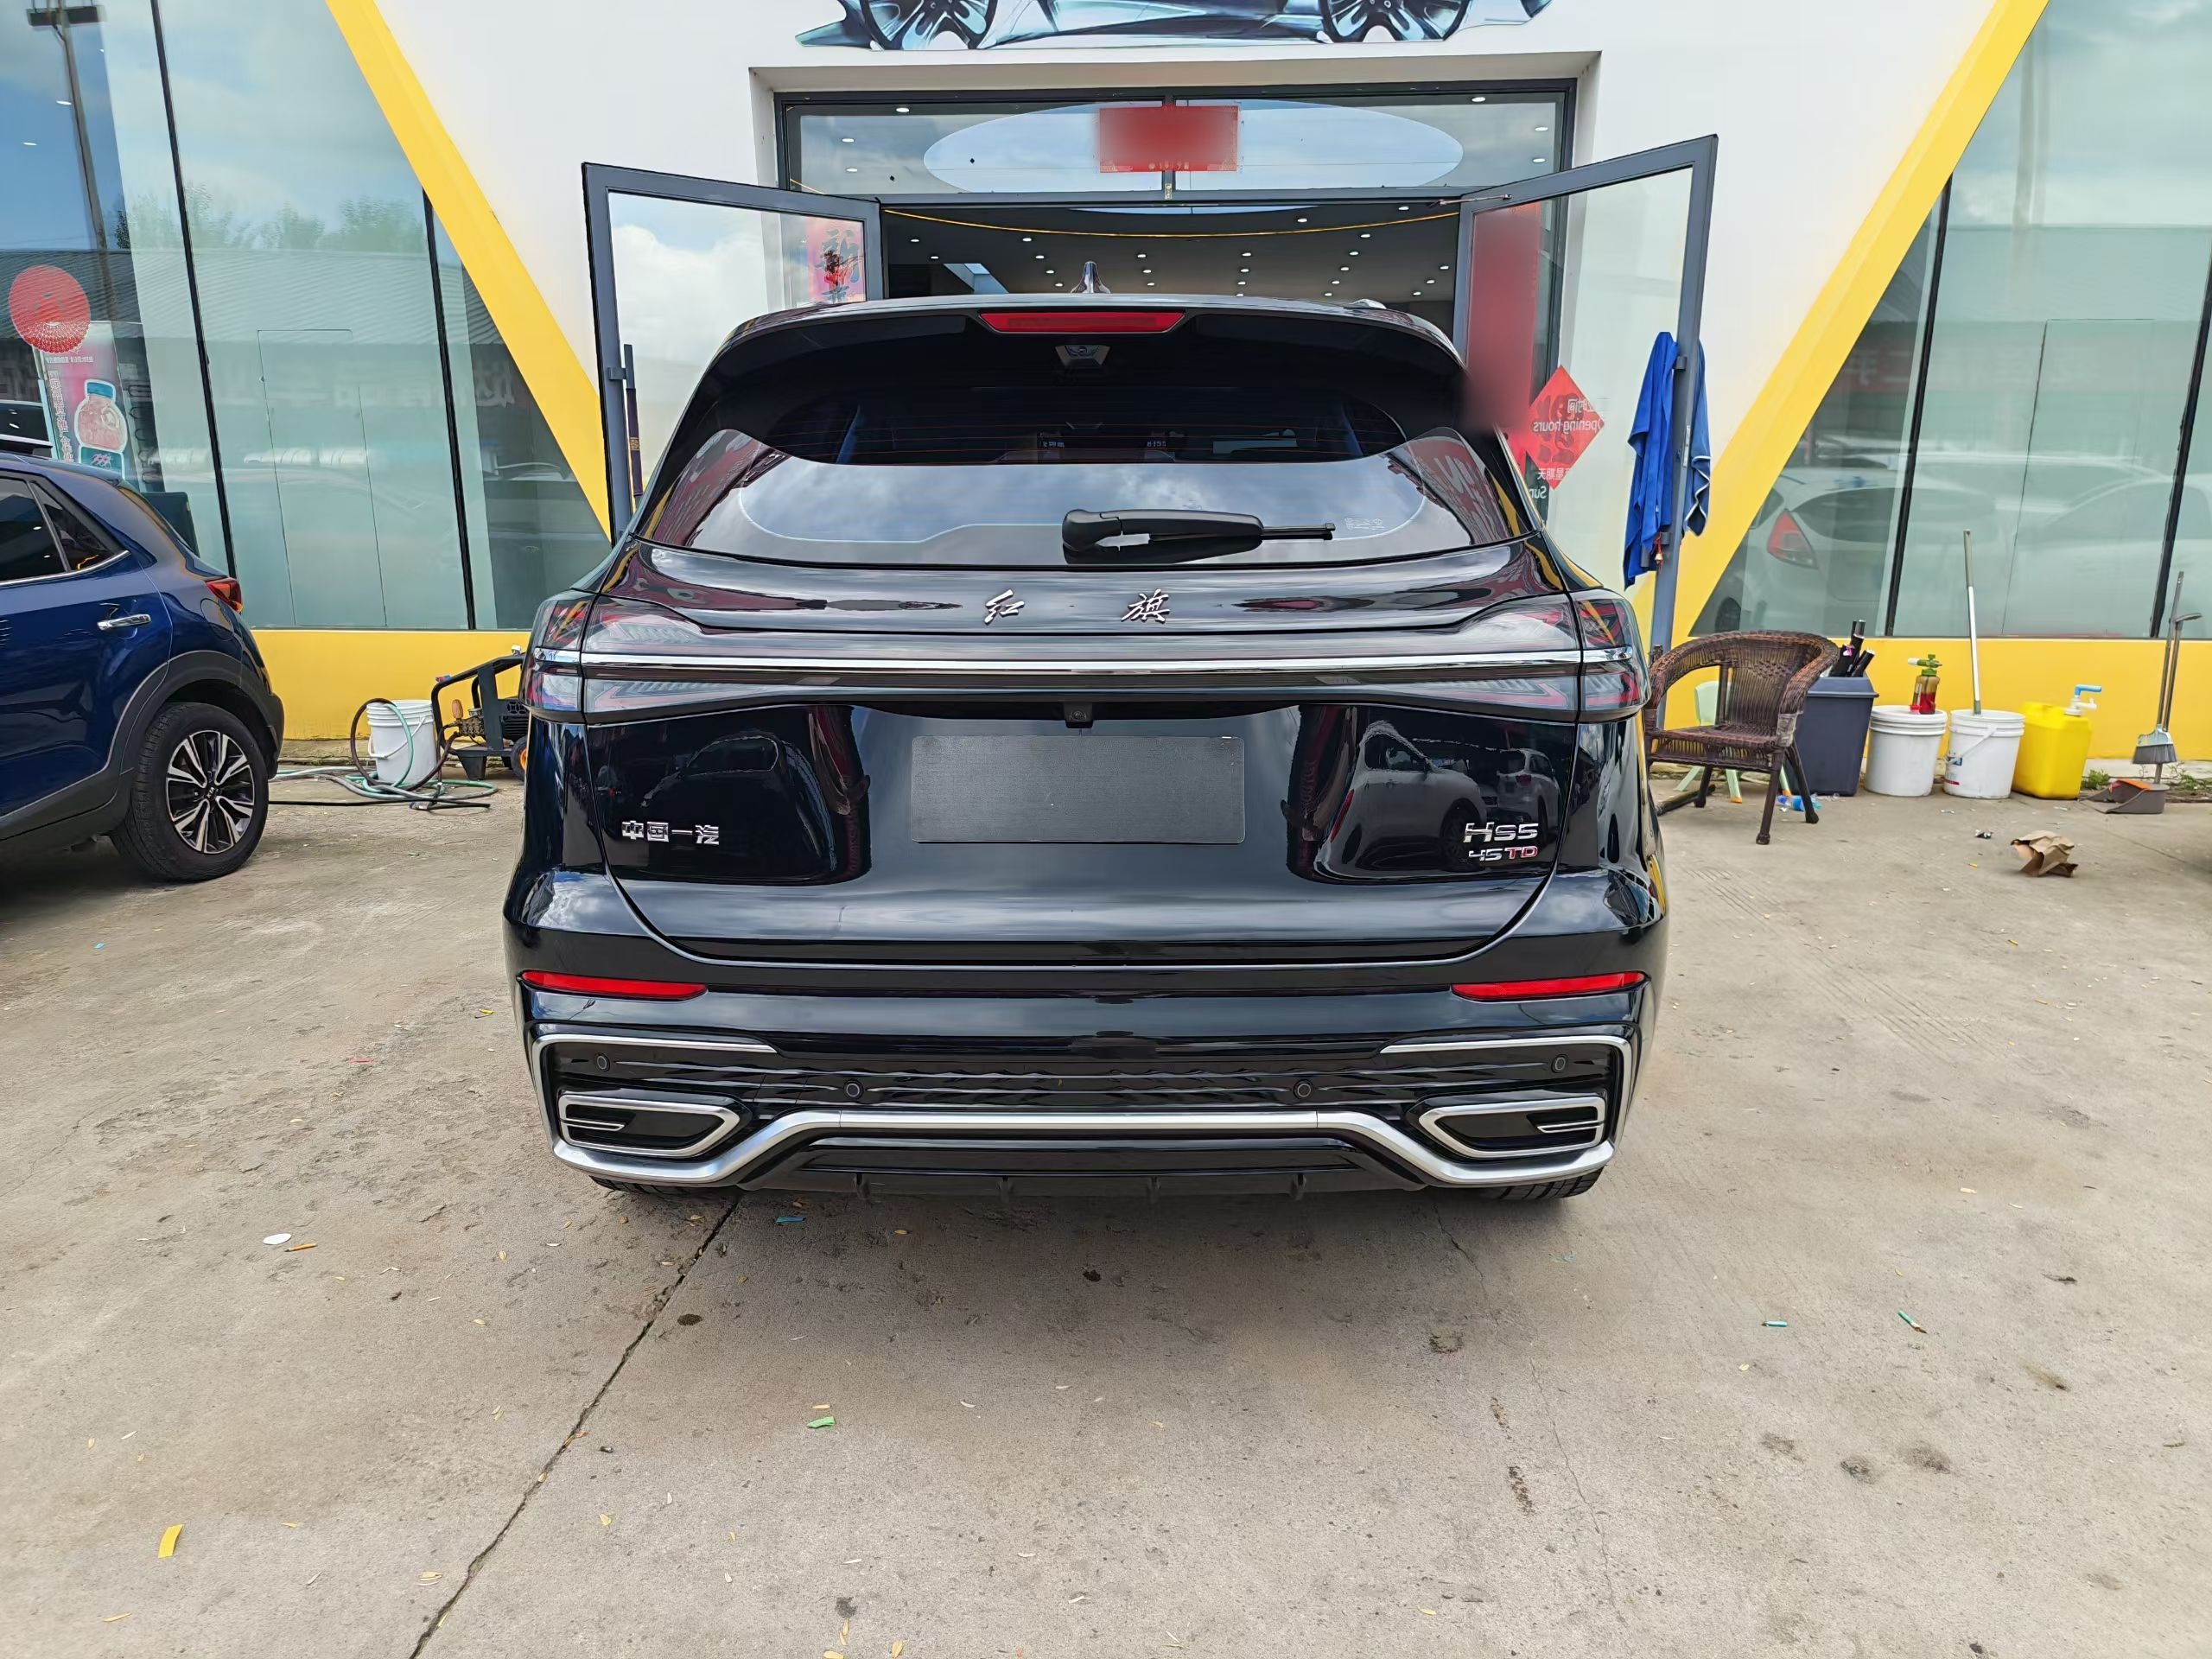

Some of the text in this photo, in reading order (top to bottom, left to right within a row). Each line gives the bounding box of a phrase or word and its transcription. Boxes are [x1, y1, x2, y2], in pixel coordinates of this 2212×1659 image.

[983, 588, 1171, 626] 红旗
[621, 820, 720, 845] 中国一汽
[1463, 822, 1539, 843] HS5
